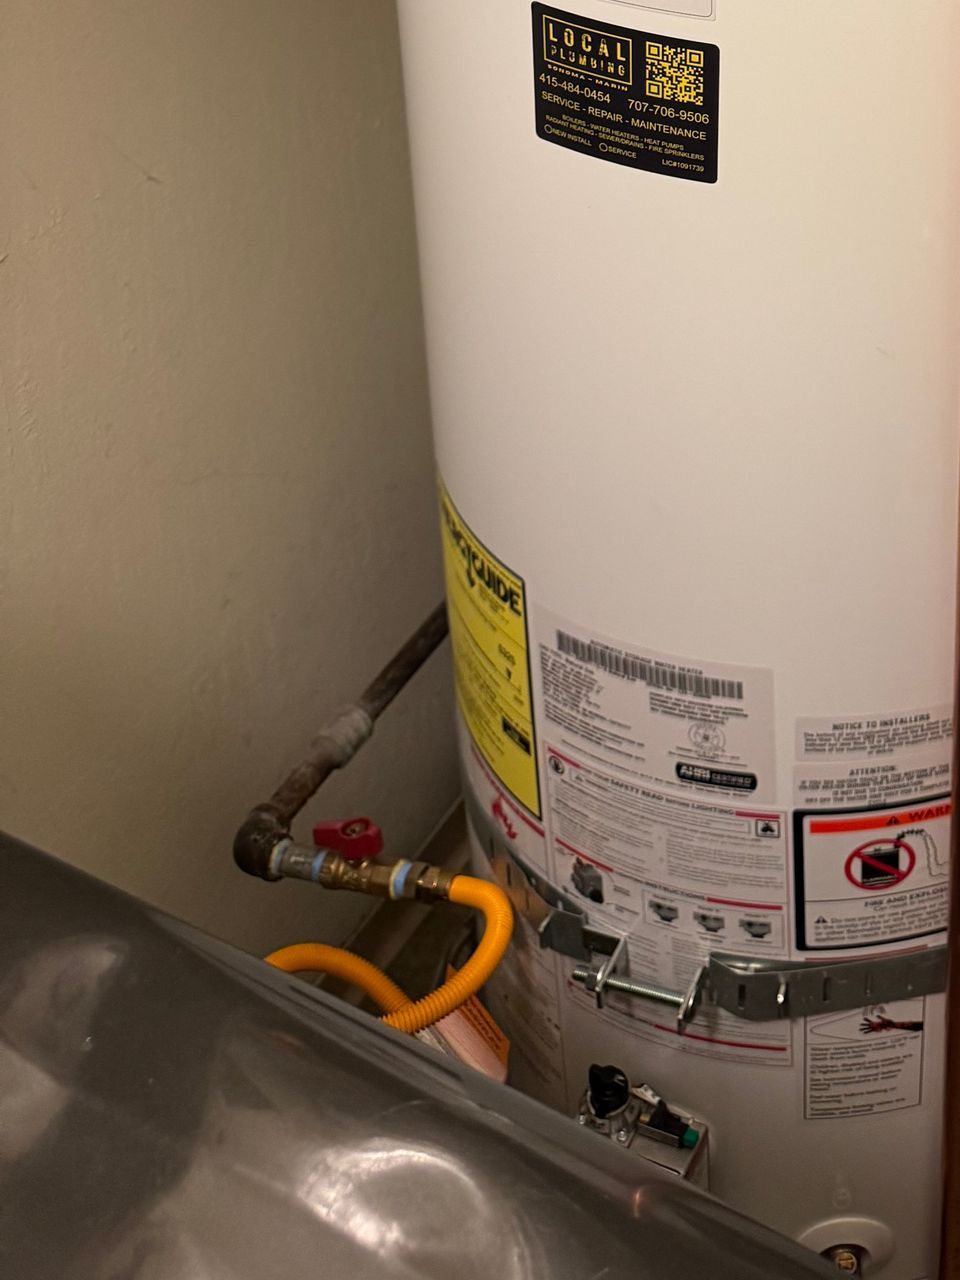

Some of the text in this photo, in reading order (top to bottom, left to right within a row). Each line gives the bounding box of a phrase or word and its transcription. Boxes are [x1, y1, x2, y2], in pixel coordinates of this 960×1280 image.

[549, 23, 626, 61] LOCAL
[550, 45, 625, 76] PLUMBING
[540, 73, 610, 103] 415-484-0454
[548, 64, 585, 80] SONOMA
[596, 79, 628, 91] MARIN
[542, 91, 580, 111] SERVICE
[588, 107, 623, 123] REPAIR
[631, 118, 706, 140] MAINTENANCE
[628, 99, 709, 124] 707-706-9506
[568, 133, 592, 146] INSTALL
[591, 123, 611, 133] WATER
[612, 129, 639, 141] HEATERS
[662, 142, 684, 150] PUMPS
[608, 146, 637, 158] SERVICE
[649, 145, 663, 153] FIRE
[664, 148, 704, 160] SPRINKLERS
[832, 721, 865, 731] NOTICE
[867, 720, 878, 729] TO
